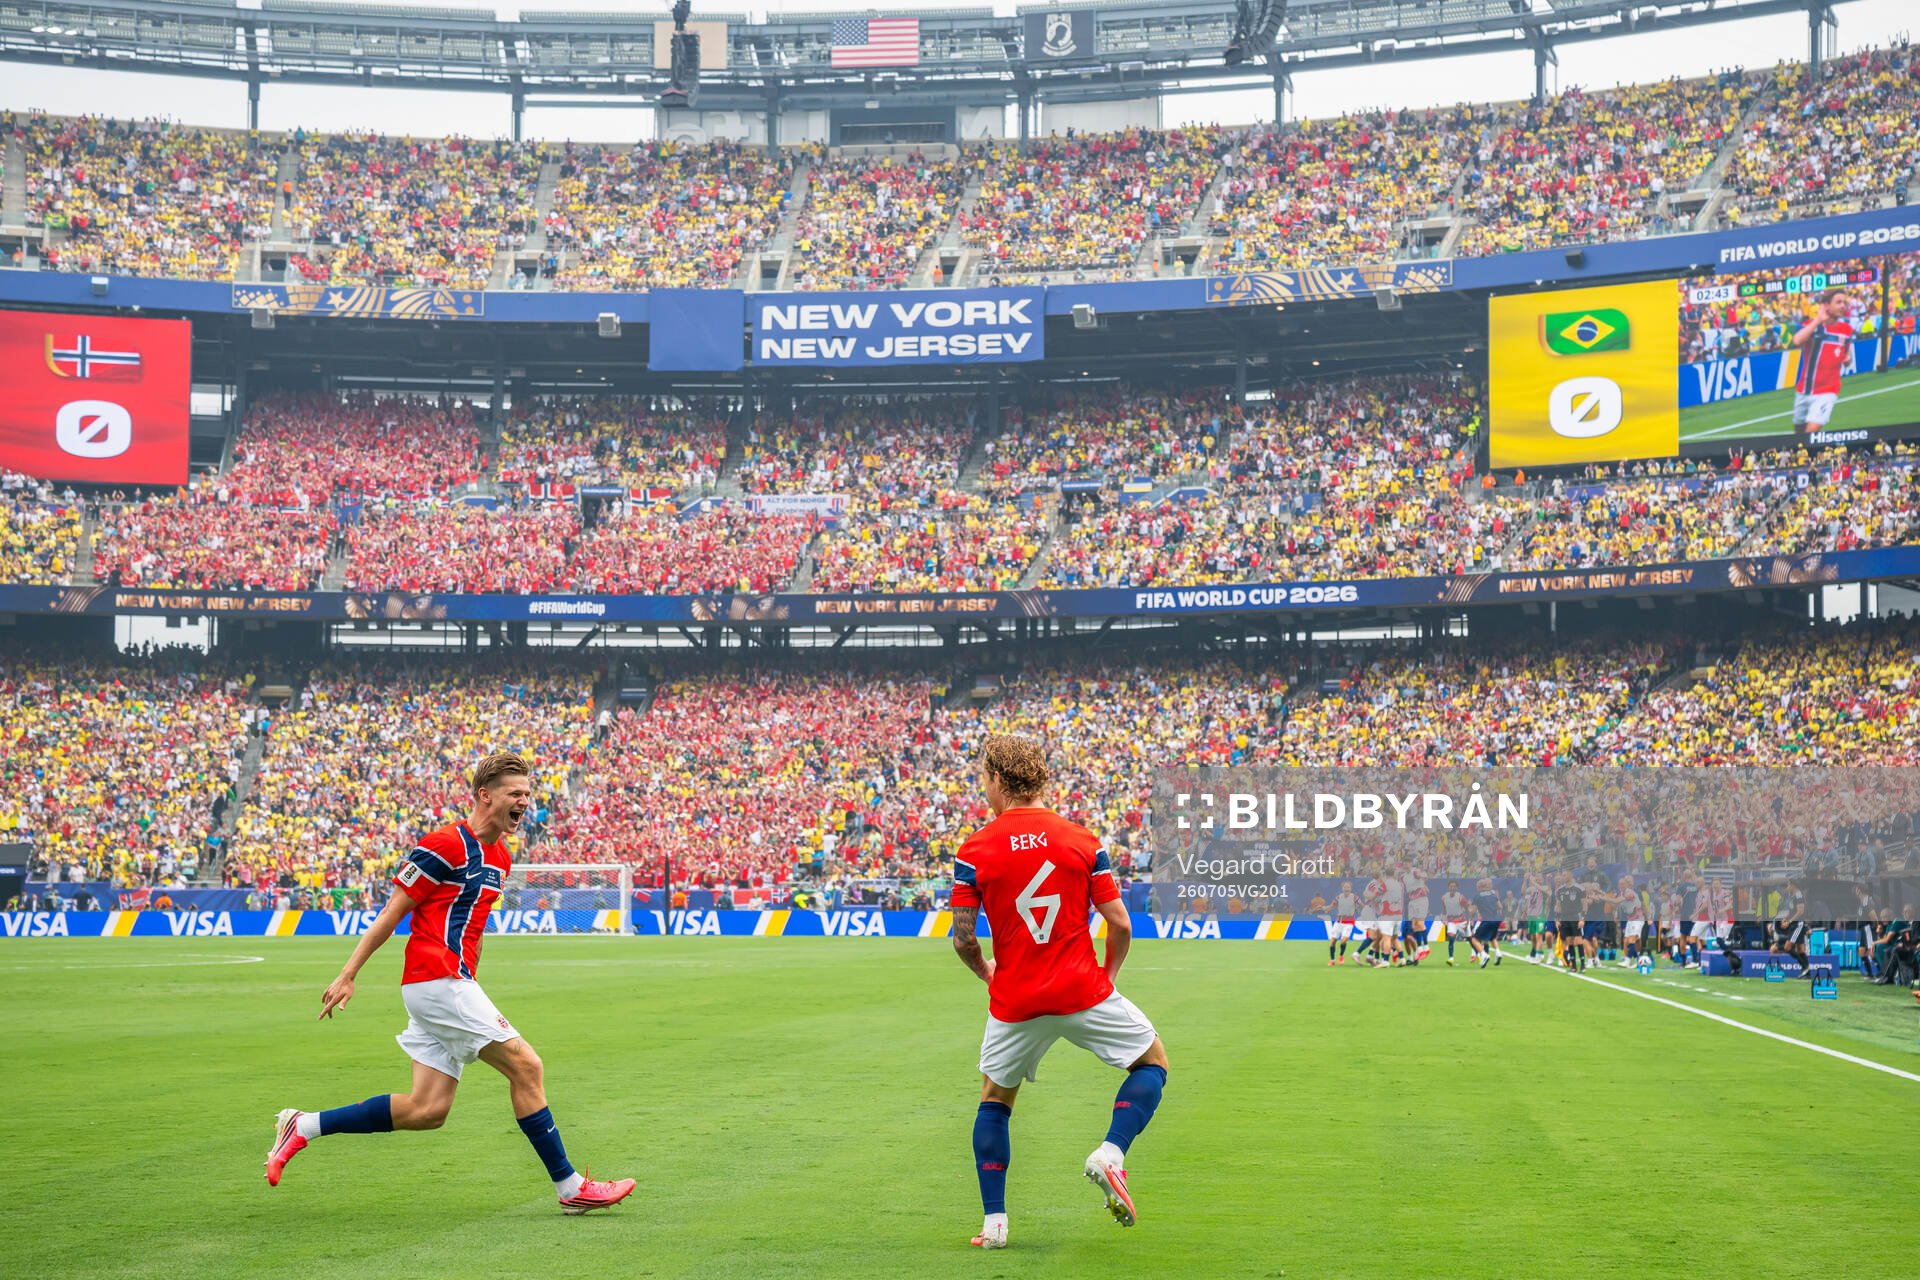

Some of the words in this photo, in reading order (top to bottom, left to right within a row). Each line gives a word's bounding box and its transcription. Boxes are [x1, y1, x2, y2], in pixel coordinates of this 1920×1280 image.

[1720, 247, 1756, 264] FIFA
[1757, 238, 1819, 258] WORLD
[1822, 232, 1856, 250] CUP
[1858, 223, 1920, 245] 2026
[1696, 287, 1730, 301] 02:43
[1765, 281, 1784, 293] BRA
[1829, 272, 1848, 286] NOR
[761, 304, 879, 331] NEW
[889, 299, 1033, 328] YORK
[761, 338, 857, 359] NEW
[865, 332, 1033, 358] JERSEY
[1693, 357, 1754, 404] VISA
[1810, 429, 1869, 445] Hisense
[1500, 579, 1537, 593] NEW
[1541, 576, 1585, 591] YORK
[1588, 573, 1626, 589] NEW
[1629, 569, 1694, 587] JERSEY
[116, 594, 155, 608] NEW
[158, 595, 204, 610] YORK
[207, 597, 245, 610] NEW
[248, 598, 312, 612] JERSEY
[529, 601, 606, 616] #FIFAWorldCup
[815, 600, 851, 614] NEW
[855, 600, 897, 613] YORK
[900, 599, 935, 613] NEW
[937, 598, 997, 613] JERSEY
[1136, 593, 1176, 609] FIFA
[1178, 590, 1246, 607] WORLD
[1249, 588, 1287, 605] CUP
[1289, 586, 1358, 604] 2026
[1010, 831, 1048, 851] BERG
[1015, 859, 1061, 945] 6
[0, 912, 69, 936] VISA
[163, 911, 234, 936] VISA
[325, 911, 382, 936] VIS
[489, 910, 558, 936] VISA
[650, 910, 721, 935] VISA
[814, 911, 886, 936] VISA
[1148, 913, 1222, 938] VISA
